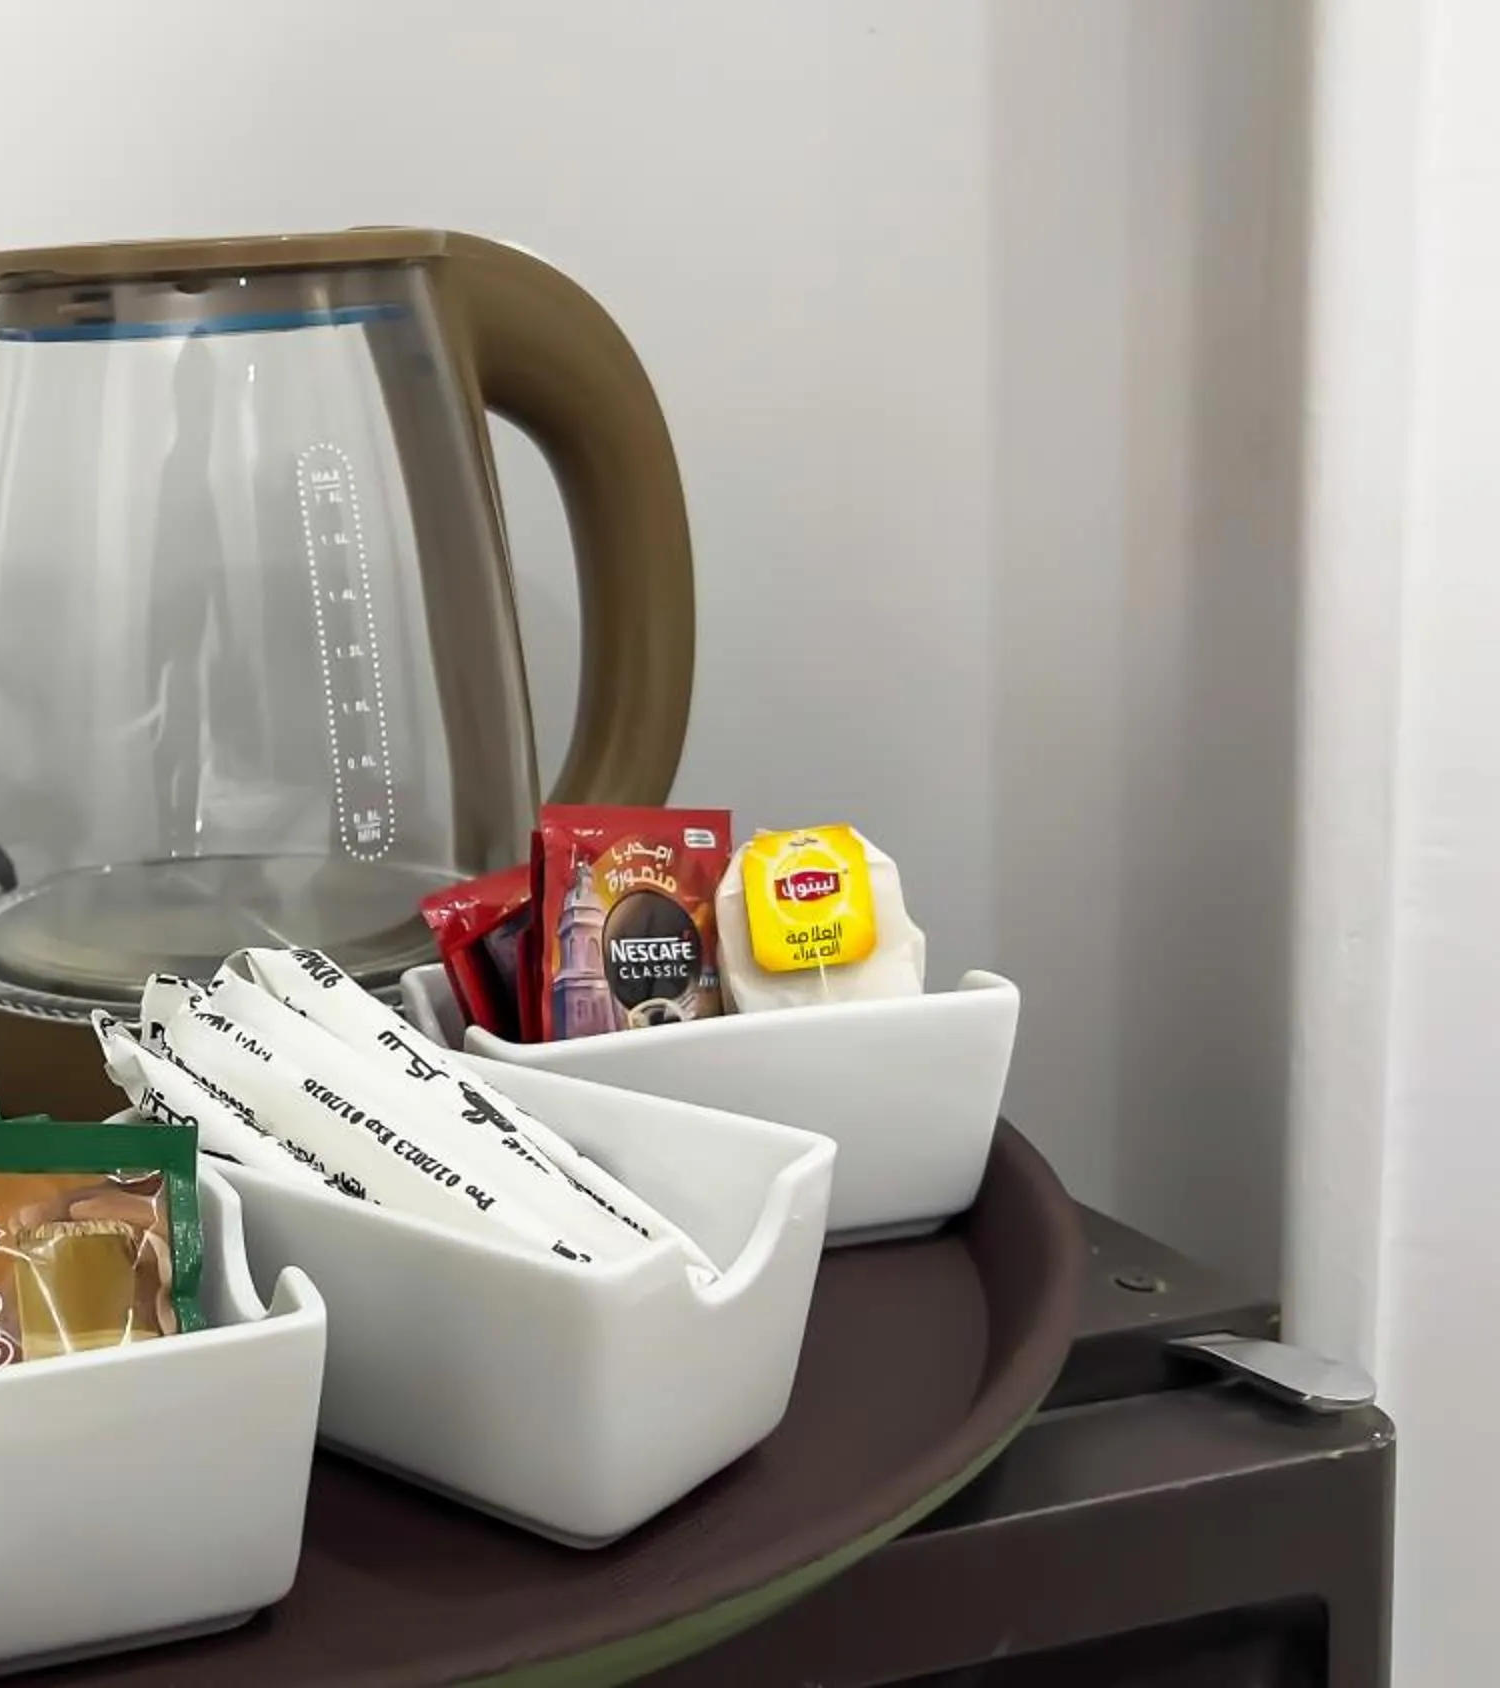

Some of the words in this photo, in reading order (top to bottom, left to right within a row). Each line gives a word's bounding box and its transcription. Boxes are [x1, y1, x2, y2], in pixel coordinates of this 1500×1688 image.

[619, 963, 689, 979] CLASSIC
[377, 1029, 451, 1081] سكر
[364, 1118, 397, 1147] Exp
[464, 1184, 497, 1212] Pro
